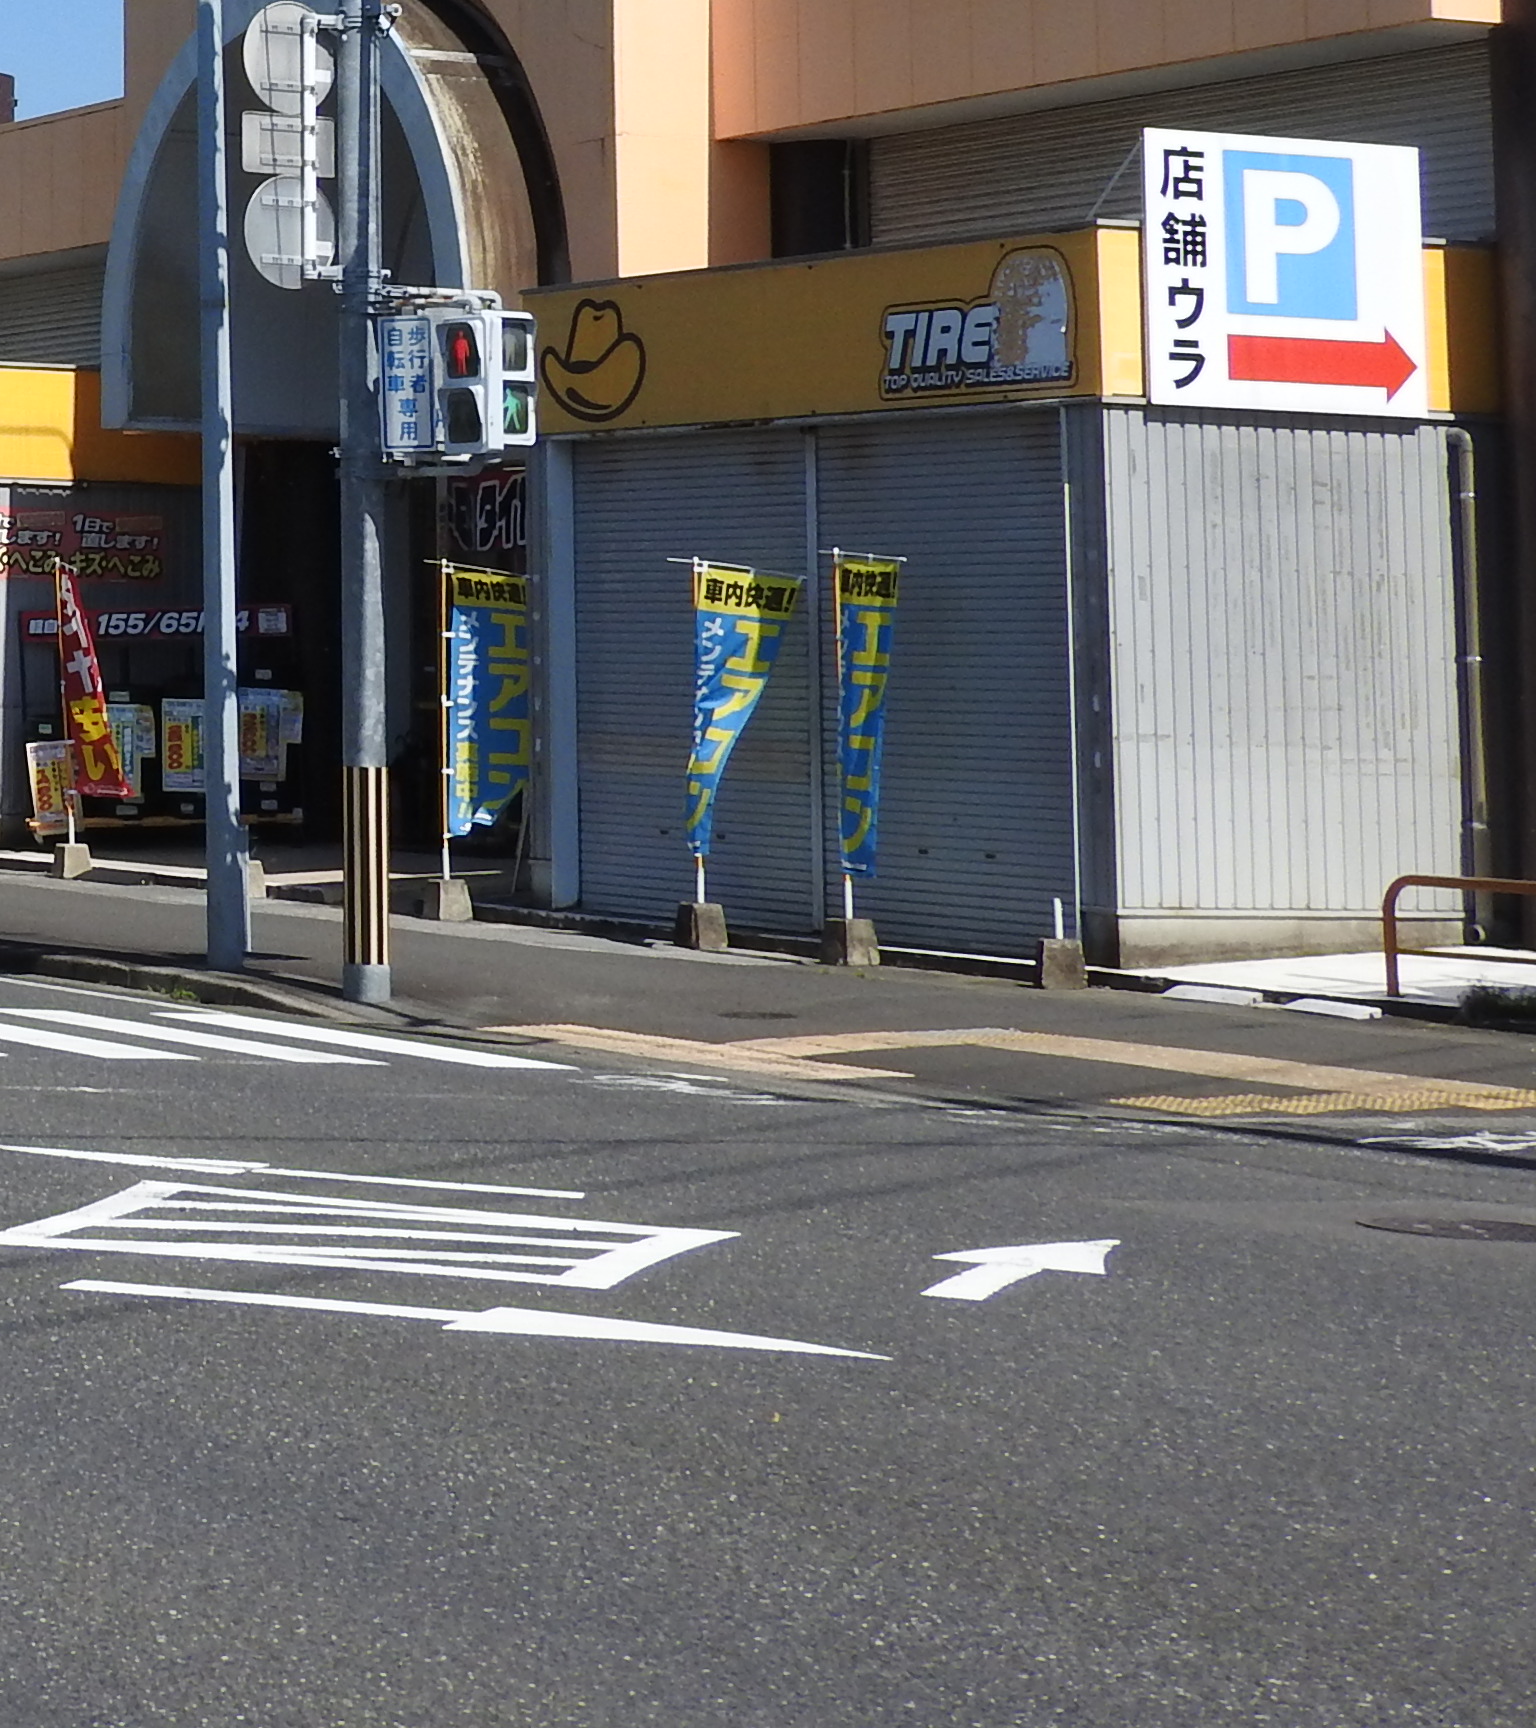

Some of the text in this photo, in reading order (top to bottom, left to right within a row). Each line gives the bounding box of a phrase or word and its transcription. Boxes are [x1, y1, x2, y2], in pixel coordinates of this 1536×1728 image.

[1160, 146, 1208, 390] 店舗ウラ
[1242, 168, 1341, 305] P
[386, 327, 406, 393] 自転車
[407, 327, 428, 394] 歩行者
[886, 304, 1000, 369] TIRE
[884, 375, 908, 389] TOP
[910, 371, 962, 388] QUALITY
[398, 398, 418, 441] 専用
[97, 610, 250, 636] 155/654
[686, 619, 780, 832] エアコン
